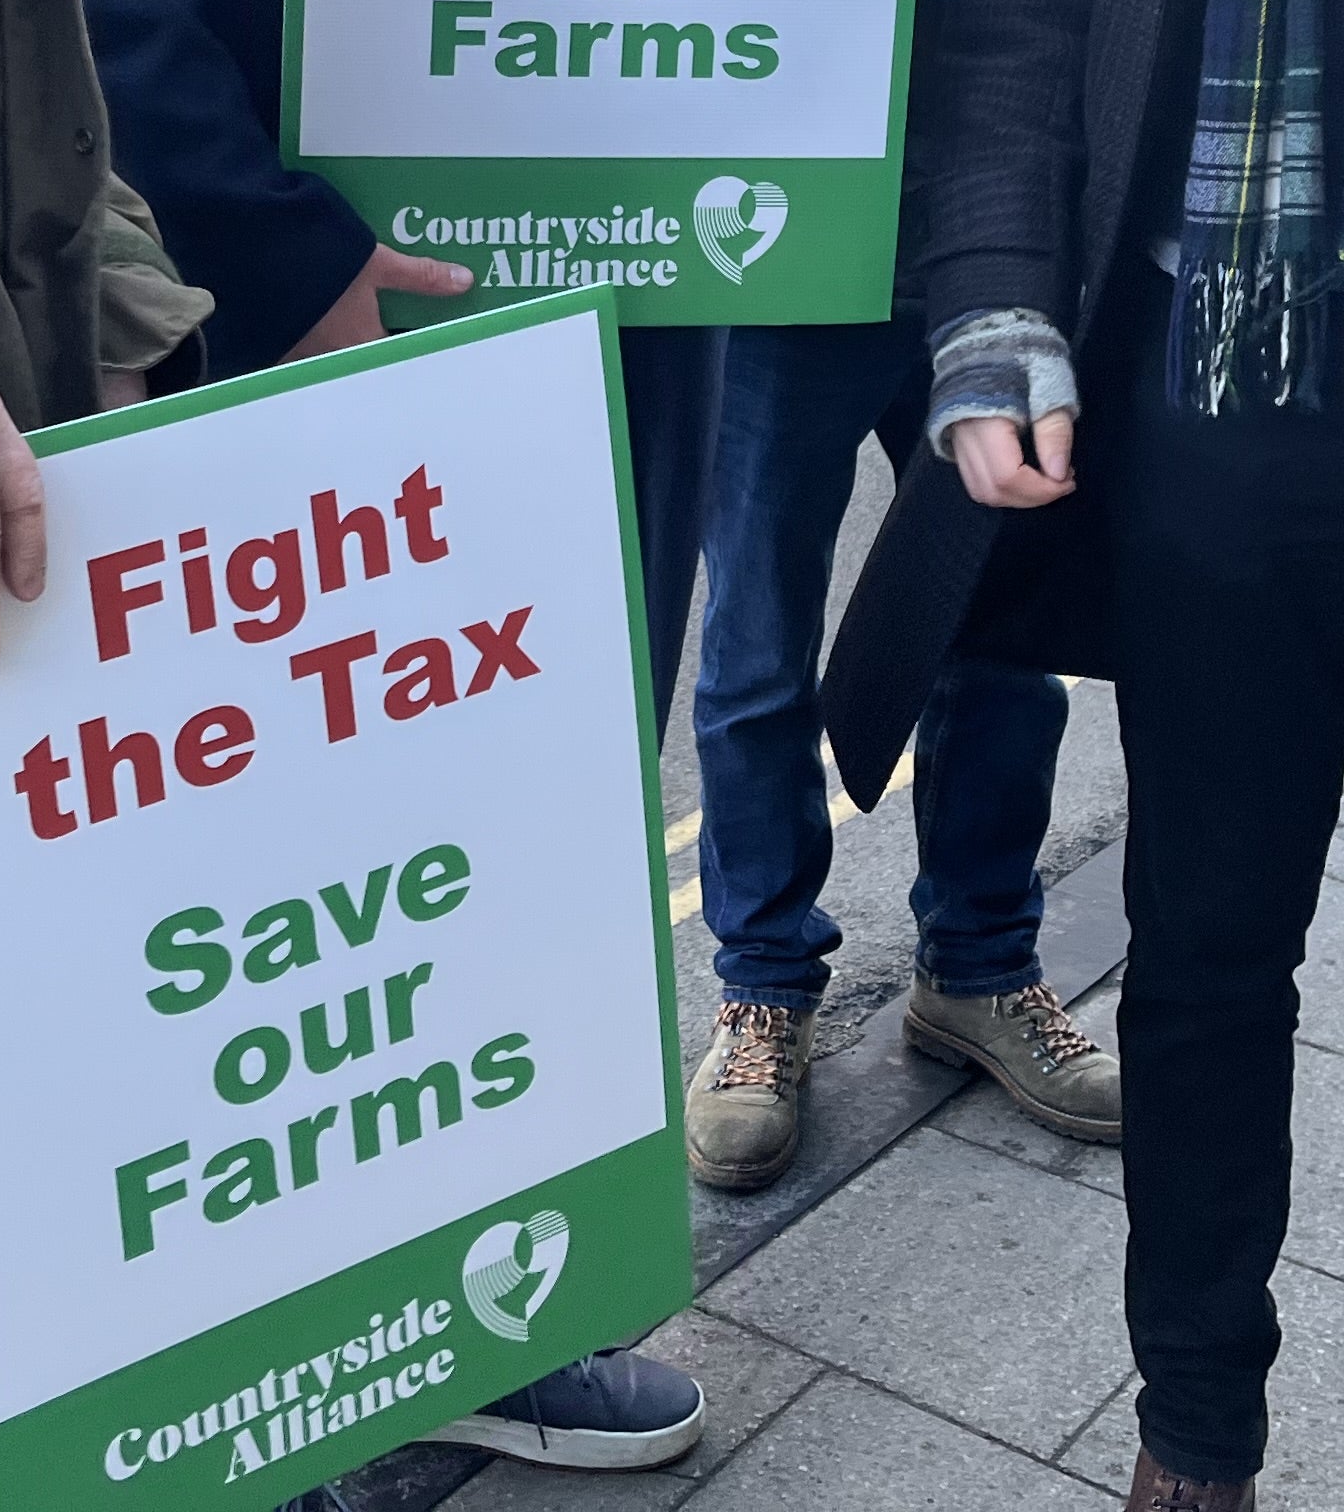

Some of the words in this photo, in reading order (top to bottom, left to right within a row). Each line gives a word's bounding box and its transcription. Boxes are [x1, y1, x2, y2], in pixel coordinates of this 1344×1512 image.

[431, 0, 780, 80] Farms
[392, 205, 681, 259] Countryside
[480, 248, 678, 288] Alliance
[90, 468, 447, 659] Fight
[16, 707, 253, 838] the
[292, 608, 538, 739] Tax
[144, 843, 471, 1016] Save
[214, 962, 433, 1106] our
[115, 1033, 535, 1262] Farms
[103, 1297, 453, 1483] Countryside
[224, 1348, 456, 1485] Alliance
